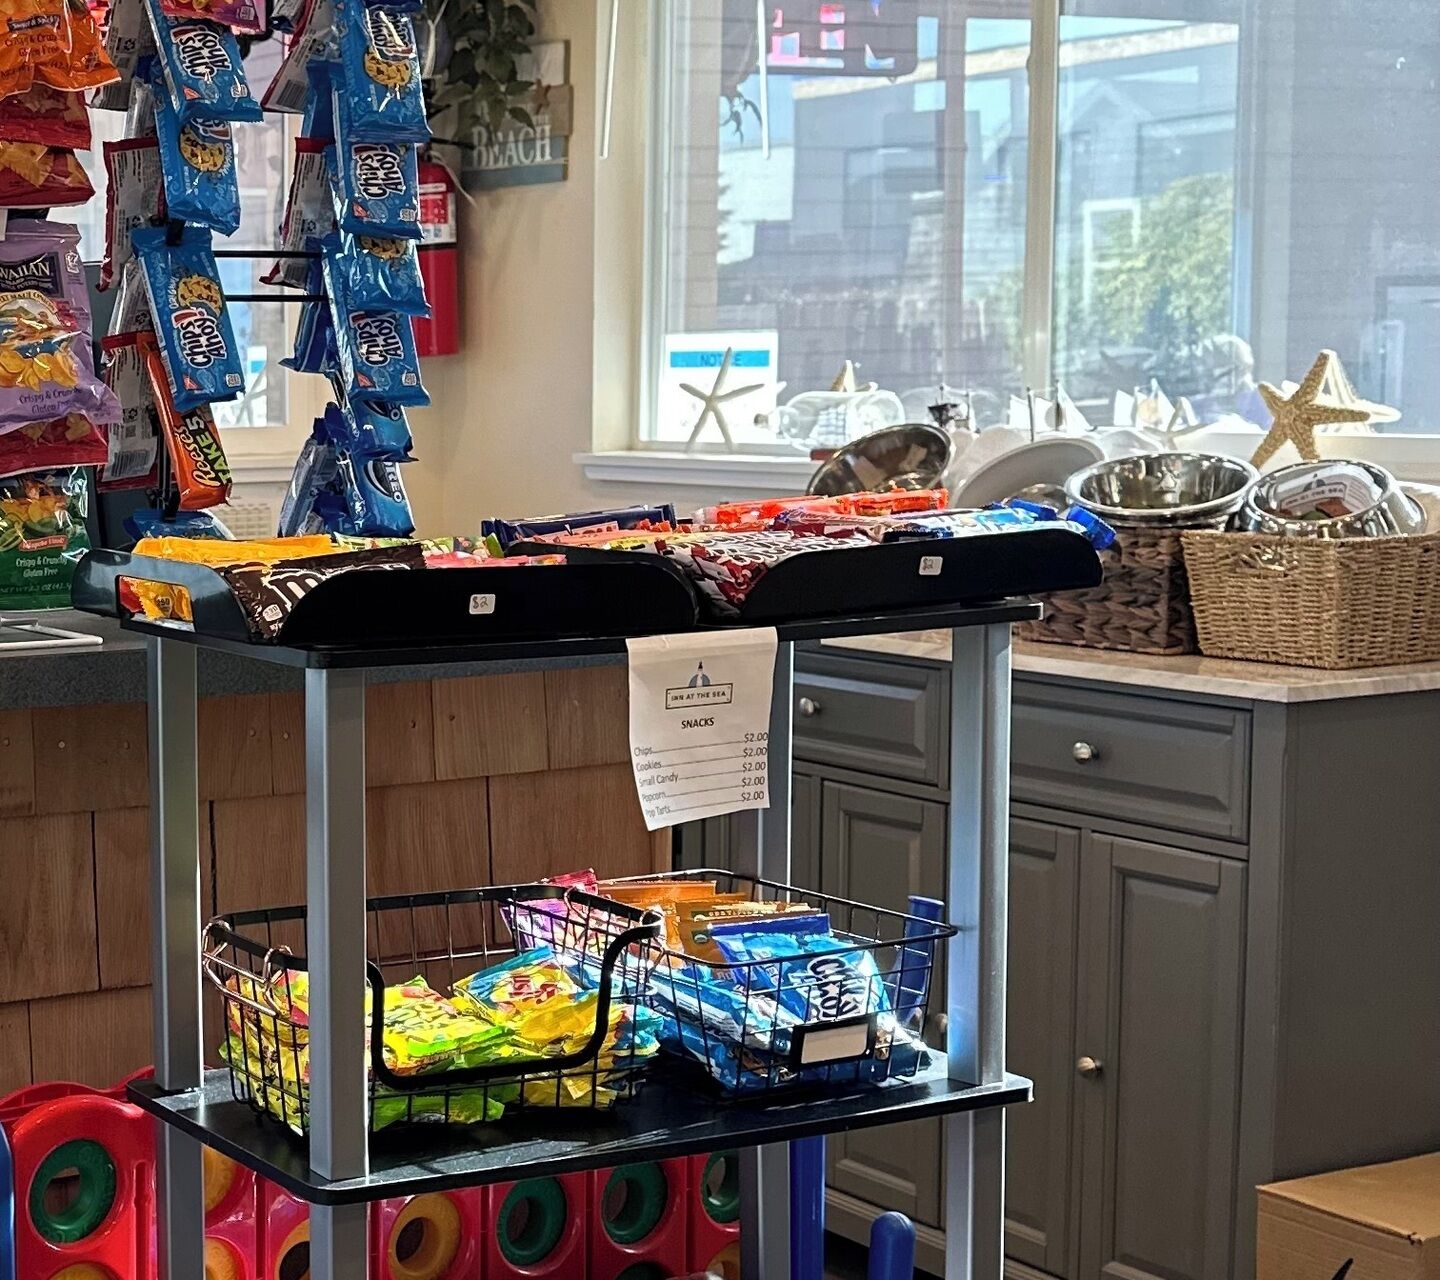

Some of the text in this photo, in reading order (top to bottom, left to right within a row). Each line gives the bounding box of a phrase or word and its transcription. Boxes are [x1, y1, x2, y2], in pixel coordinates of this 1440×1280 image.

[472, 124, 552, 169] BEACH
[358, 154, 389, 199] Chips
[181, 320, 212, 368] Chips
[700, 353, 742, 367] NOTE
[186, 417, 231, 485] TAKE 5
[385, 462, 403, 503] REO
[16, 557, 35, 567] Crispy
[472, 596, 489, 610] $2
[681, 717, 715, 730] SNACKS
[634, 732, 769, 758] Chips $2.00
[636, 747, 768, 773] Cookies $2.00
[639, 762, 766, 788] Small Candy $2.00
[741, 777, 765, 788] $2.00
[656, 805, 671, 816] Tarts
[741, 791, 765, 802] $2.00
